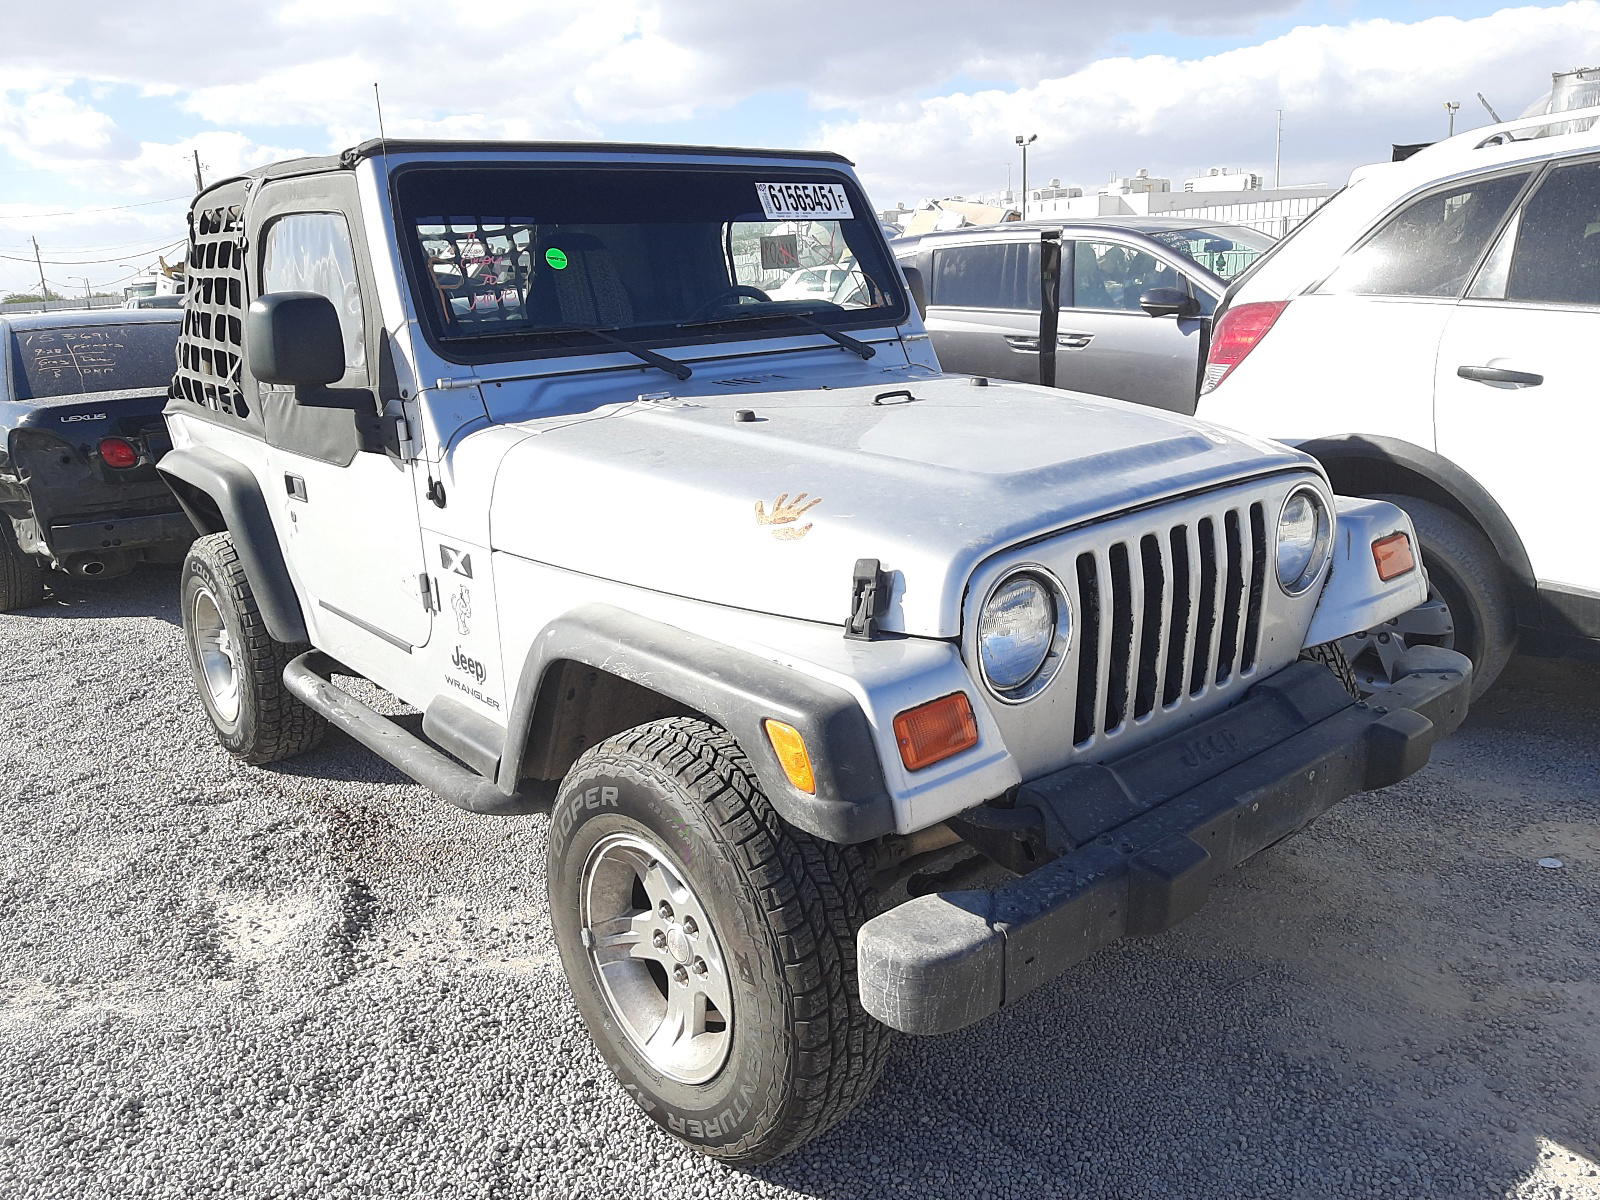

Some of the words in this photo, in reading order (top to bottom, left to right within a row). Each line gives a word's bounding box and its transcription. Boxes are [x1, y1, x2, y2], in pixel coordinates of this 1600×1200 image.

[60, 413, 107, 423] LEXUS
[451, 645, 487, 686] Jeep
[444, 674, 501, 712] WRANGLER
